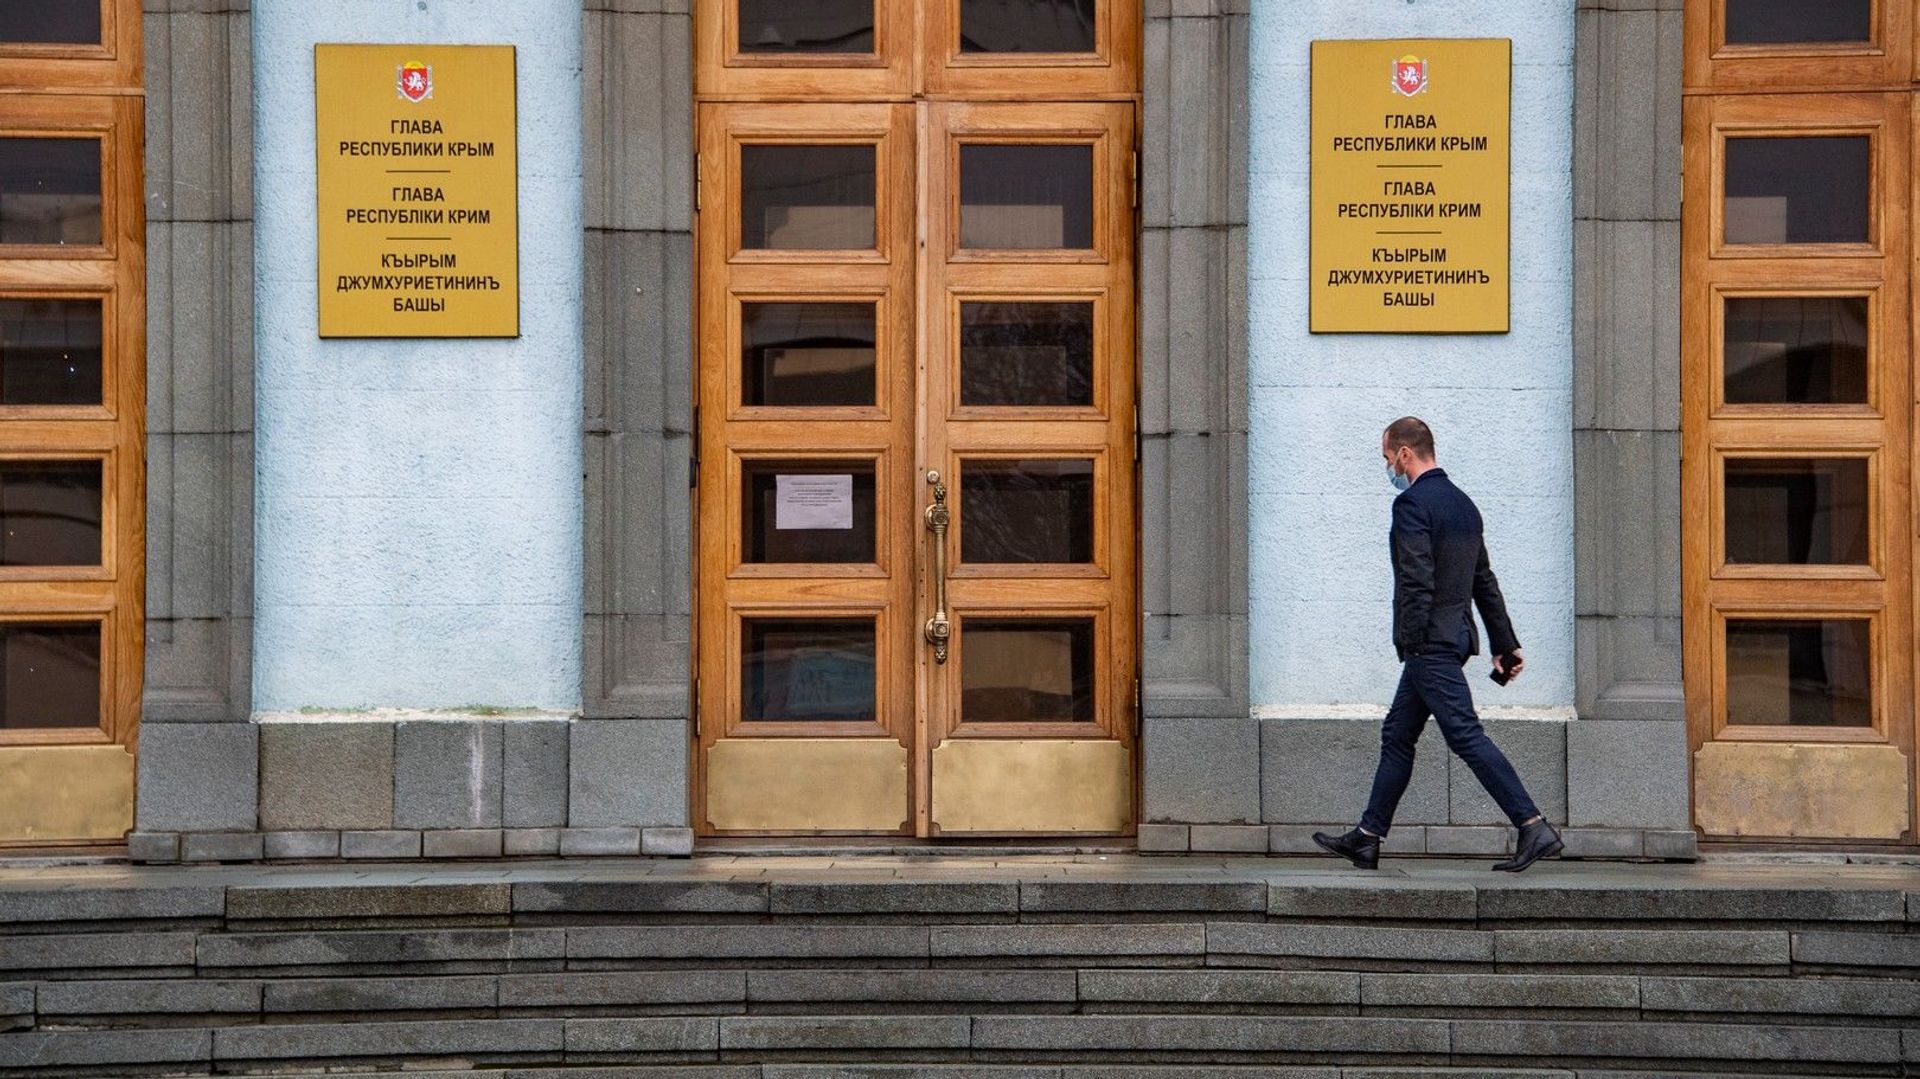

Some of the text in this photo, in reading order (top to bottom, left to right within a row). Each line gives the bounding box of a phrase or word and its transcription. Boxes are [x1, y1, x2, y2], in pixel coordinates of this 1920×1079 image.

[391, 119, 443, 134] ГЛАВА
[1385, 114, 1437, 129] ГЛАВА
[339, 141, 494, 157] РЕСПУБЛИКИ КРЫМ
[1333, 136, 1488, 152] РЕСПУБЛИКИ КРЫМ
[392, 187, 445, 202] ГЛАВА
[1384, 181, 1436, 196] ГЛАВА
[346, 208, 490, 224] РЕСПУБЛІКИ КРИМ
[1338, 203, 1481, 218] РЕСПУБЛІКИ КРИМ
[381, 253, 456, 268] КЪЫРЫМ
[1372, 248, 1447, 263] КЪЫРЫМ
[336, 275, 500, 293] ДЖУМХУРИЕТИНИНЪ
[1327, 269, 1490, 287] ДЖУМХУРИЕТИНИНЪ
[393, 297, 445, 312] БАШЫ
[1383, 292, 1435, 307] БАШЫ
